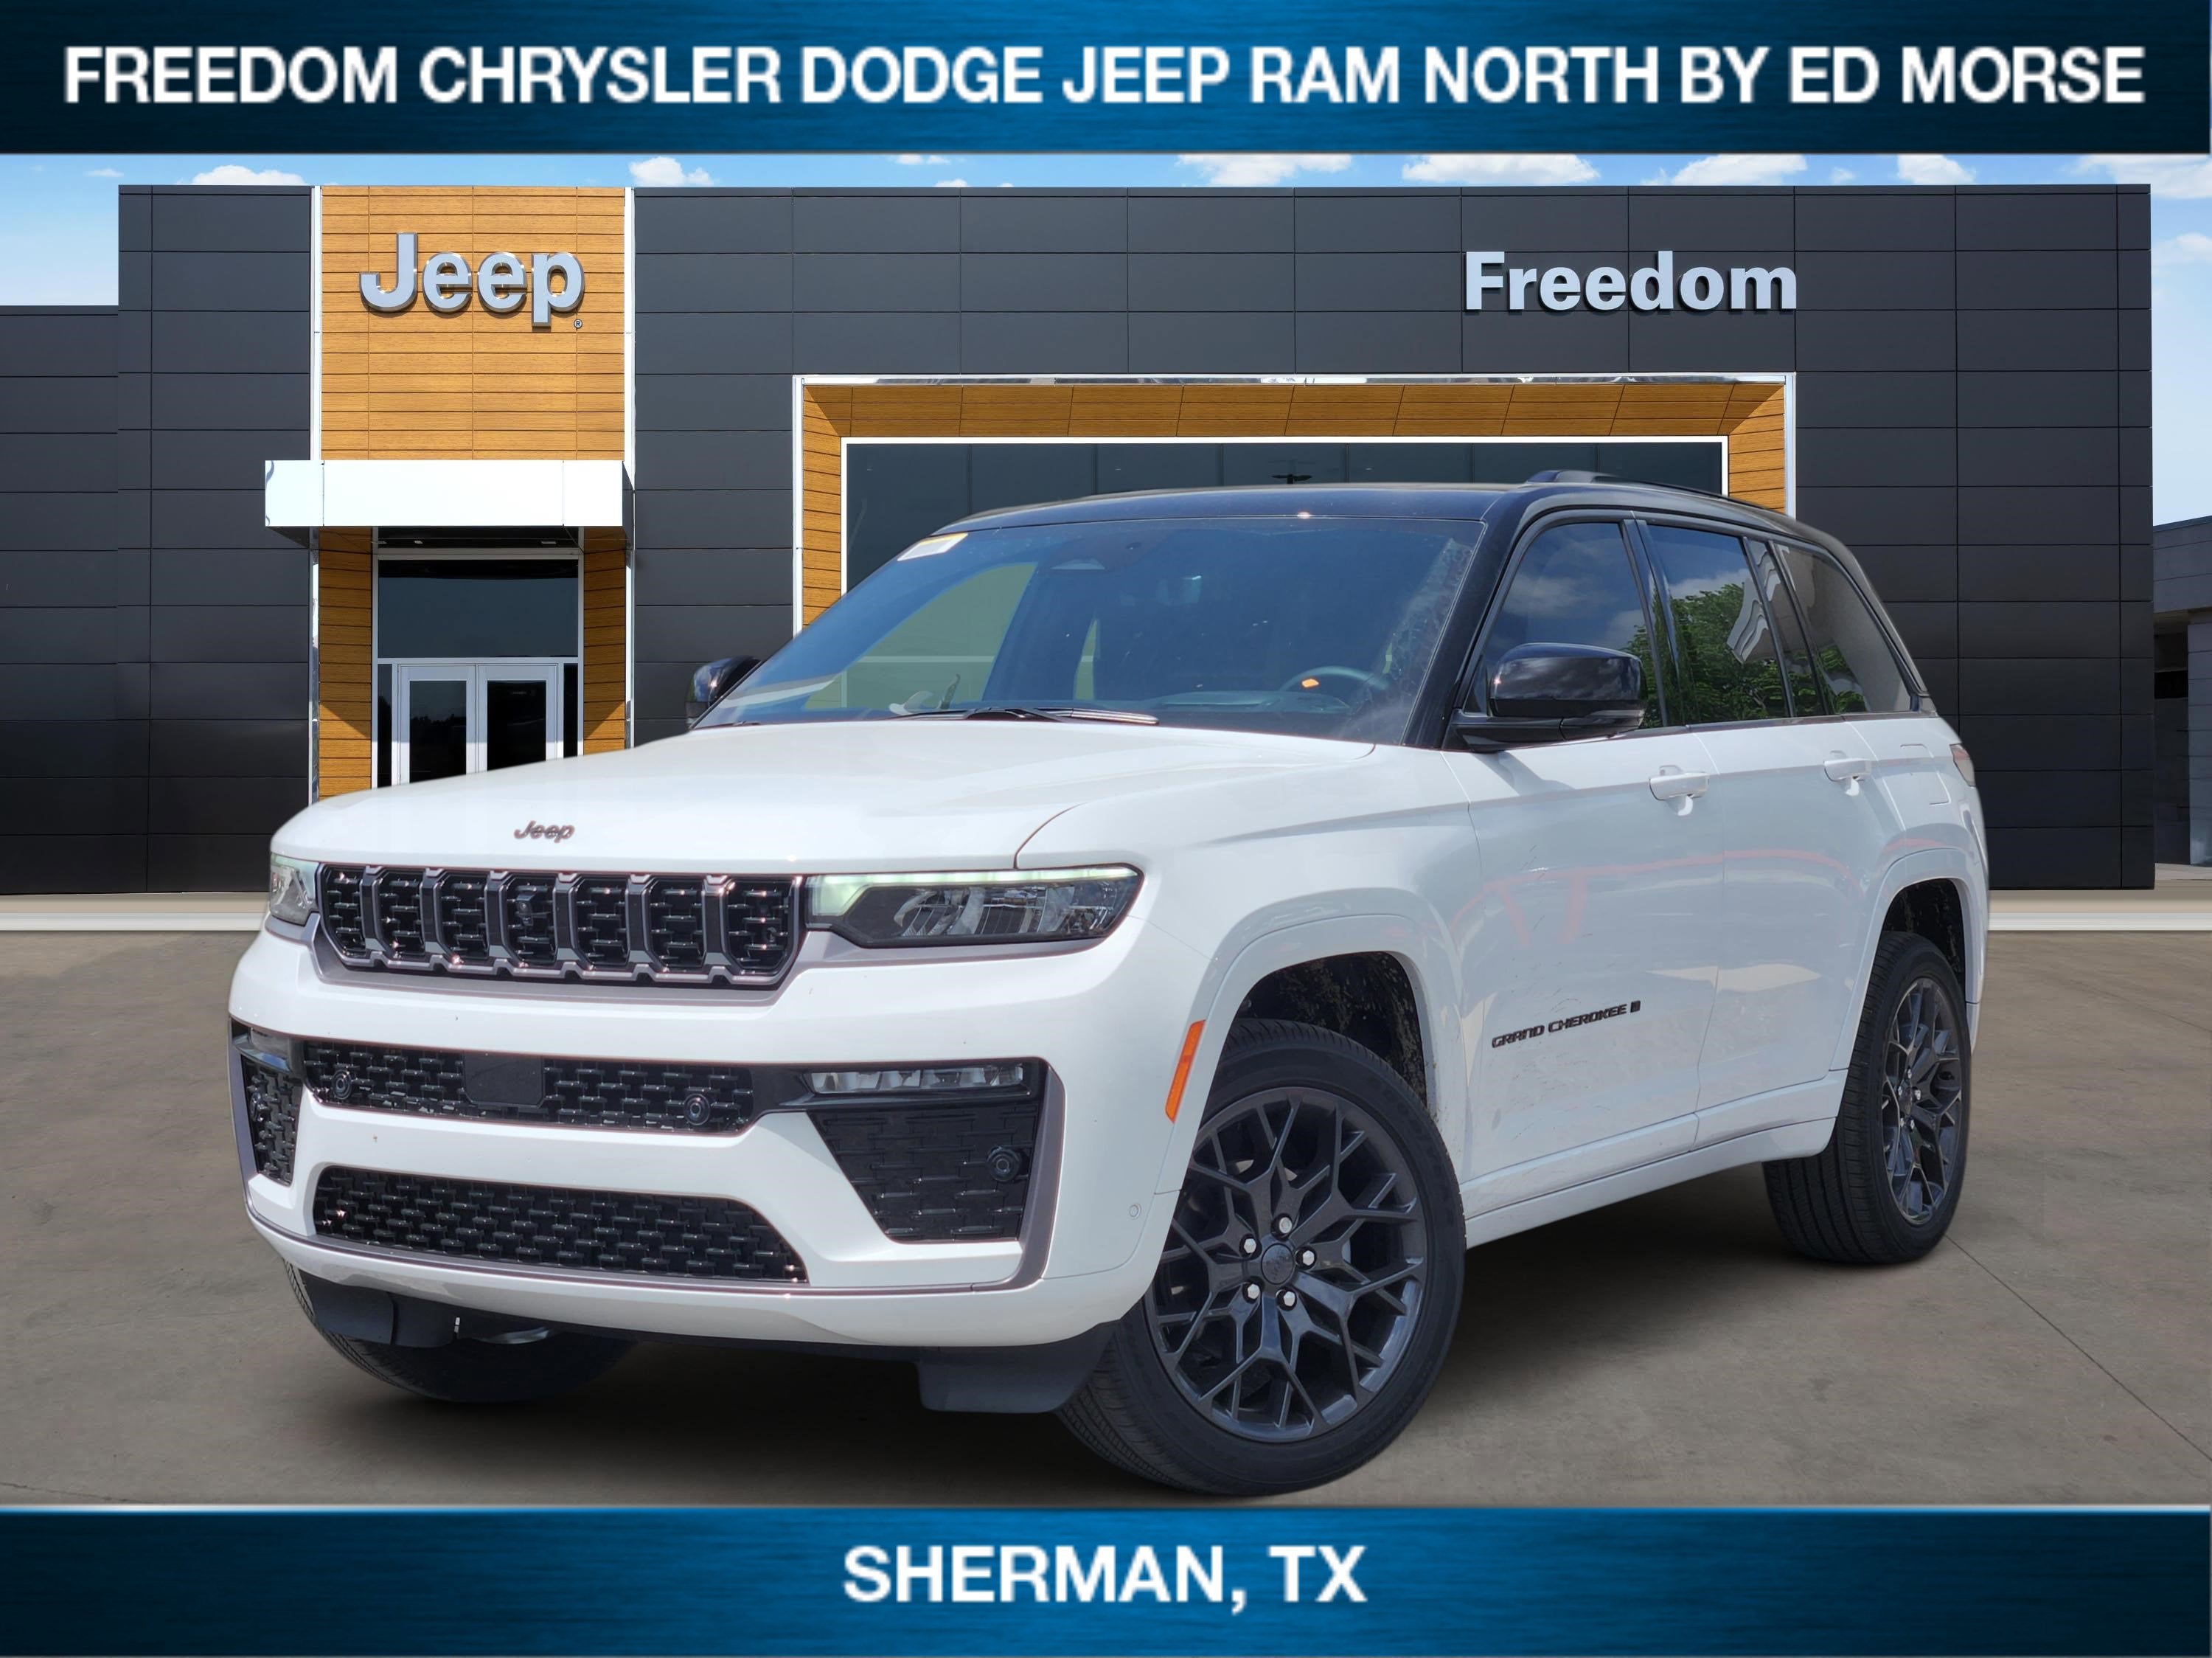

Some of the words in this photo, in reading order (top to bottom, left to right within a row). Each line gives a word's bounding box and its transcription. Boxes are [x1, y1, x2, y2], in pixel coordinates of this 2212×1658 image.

[359, 232, 585, 327] Jeep
[1465, 249, 1798, 311] Freedom
[514, 820, 574, 842] Jeep
[1492, 1024, 1545, 1048] GRAND
[1548, 1004, 1627, 1033] CHEROKEE
